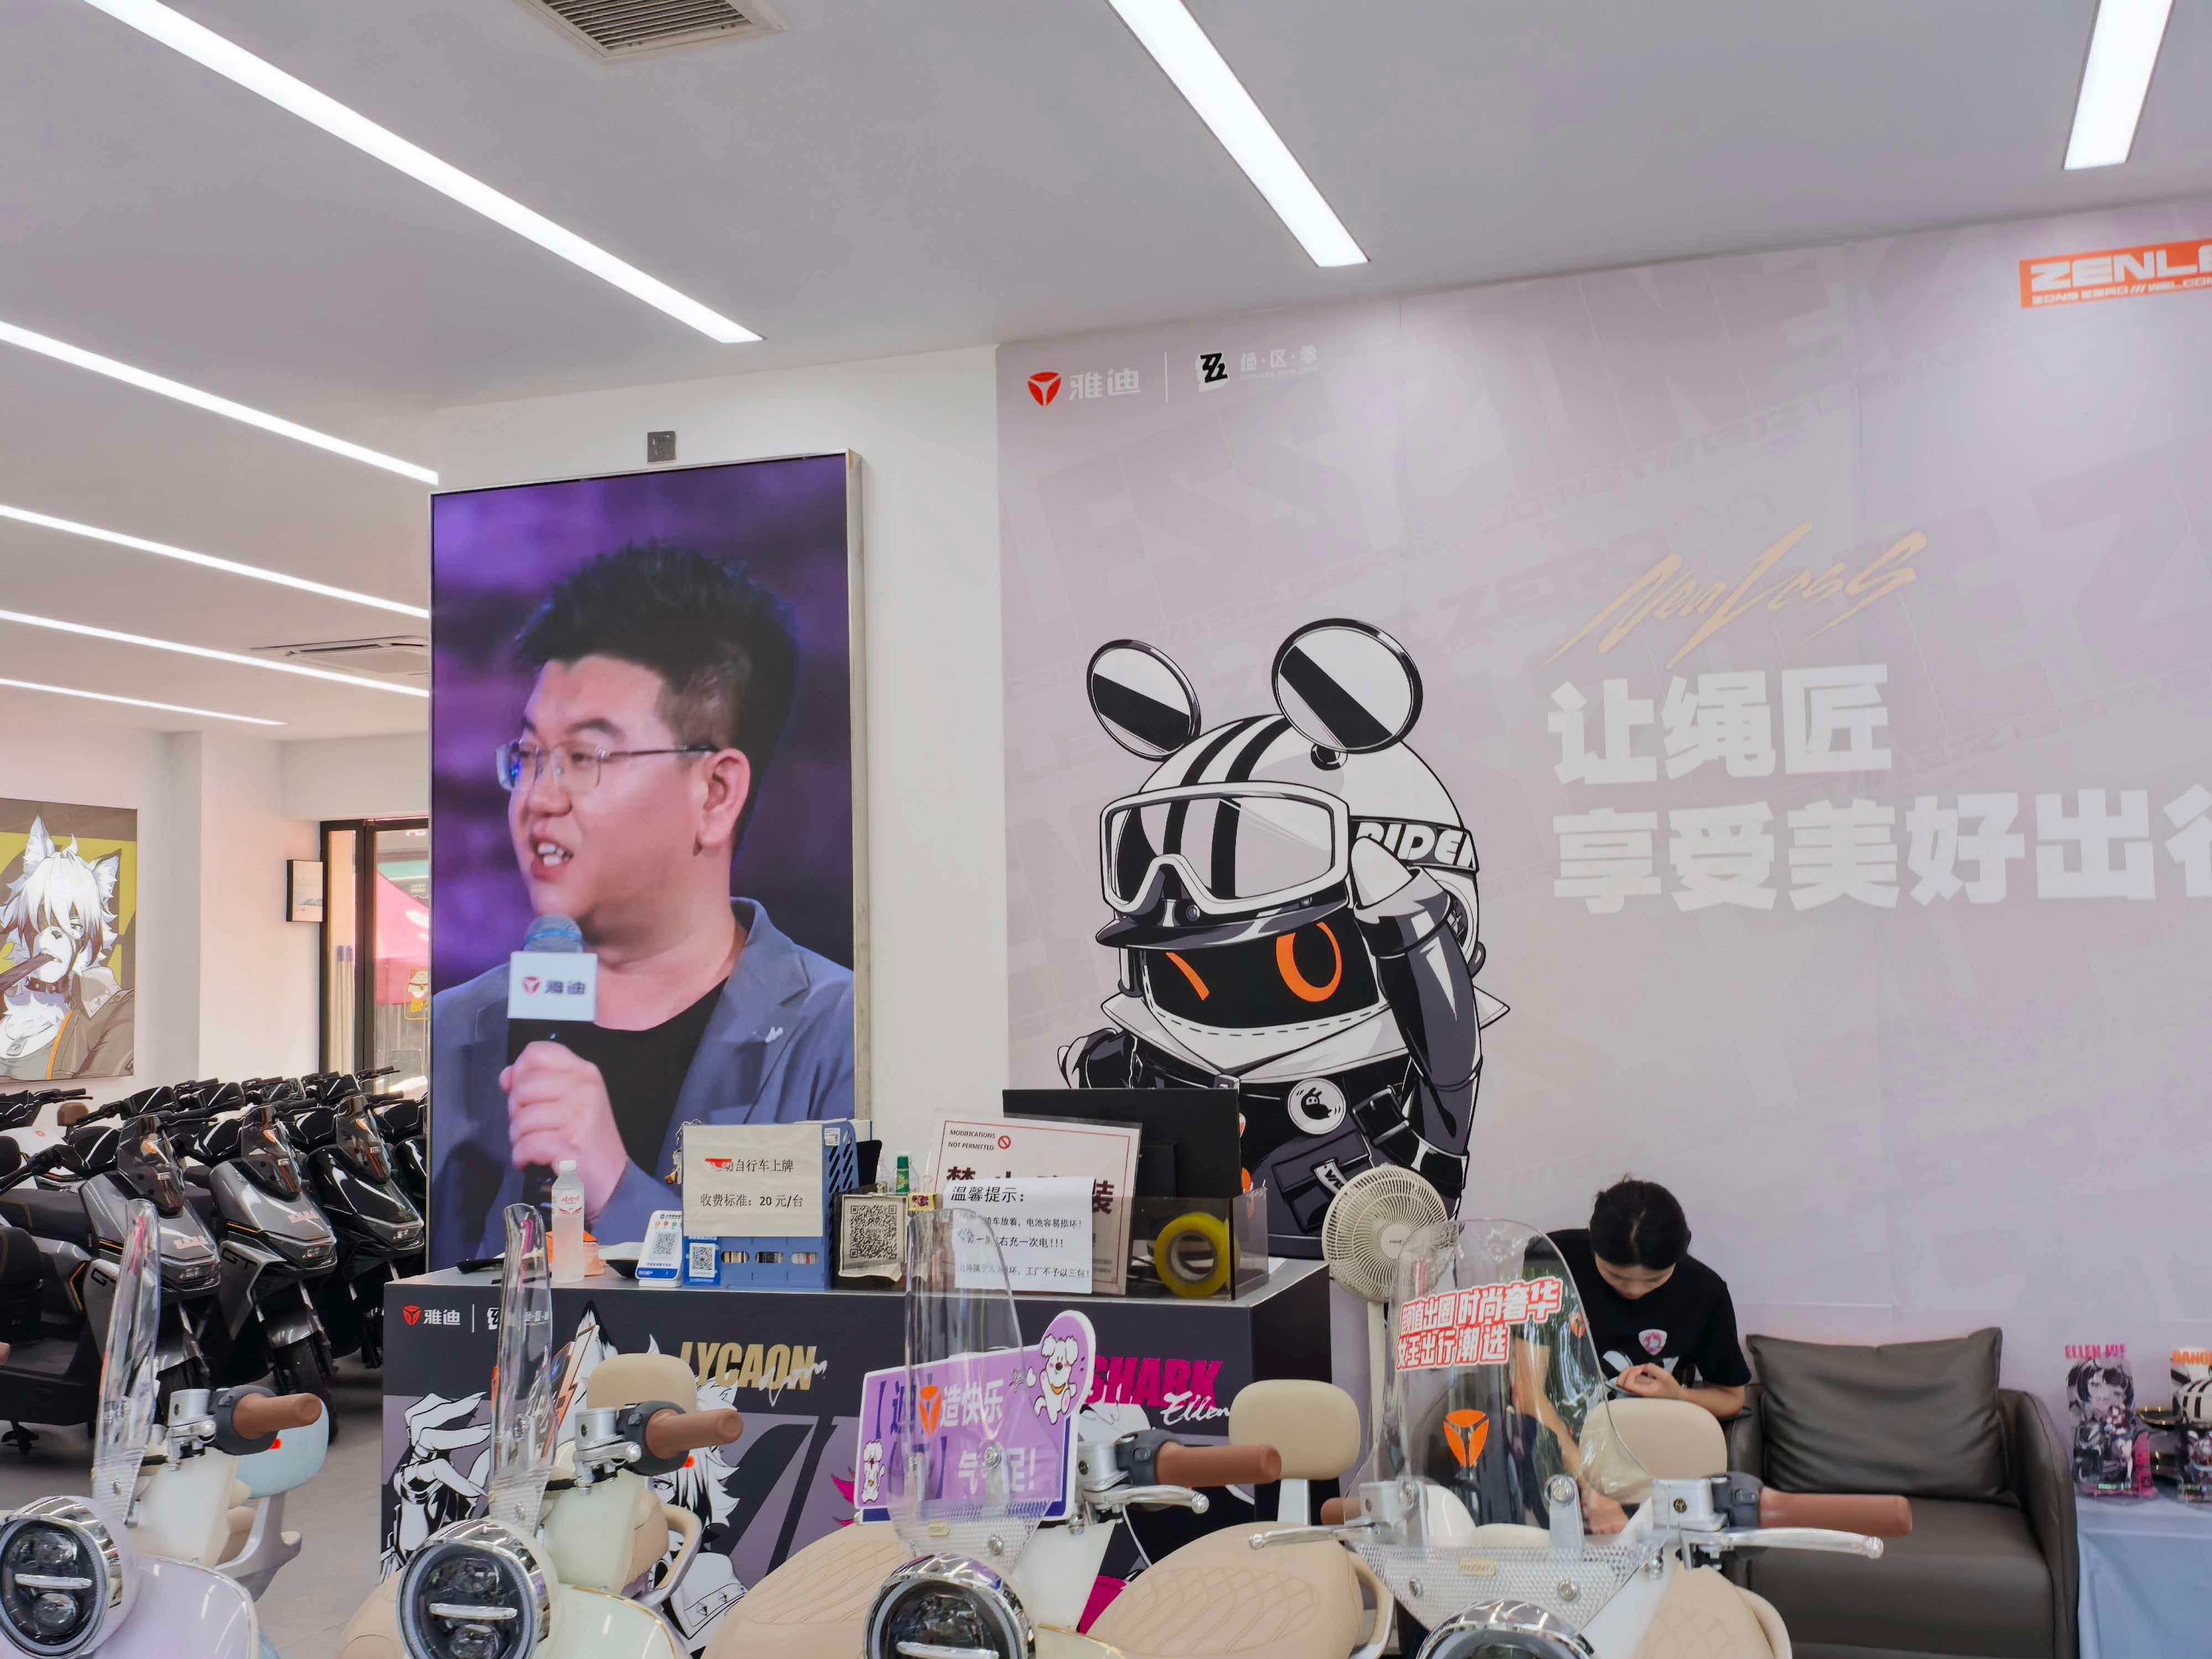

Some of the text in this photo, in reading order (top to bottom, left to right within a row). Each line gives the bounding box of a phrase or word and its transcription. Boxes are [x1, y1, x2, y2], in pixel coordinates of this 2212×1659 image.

[1069, 367, 1141, 401] 雅迪
[1548, 663, 1892, 786] 让绳匠
[950, 1130, 996, 1139] MODIFICATIONS
[951, 1186, 1025, 1203] 温馨提示：
[221, 1248, 258, 1270] GT
[423, 1309, 461, 1326] 雅迪
